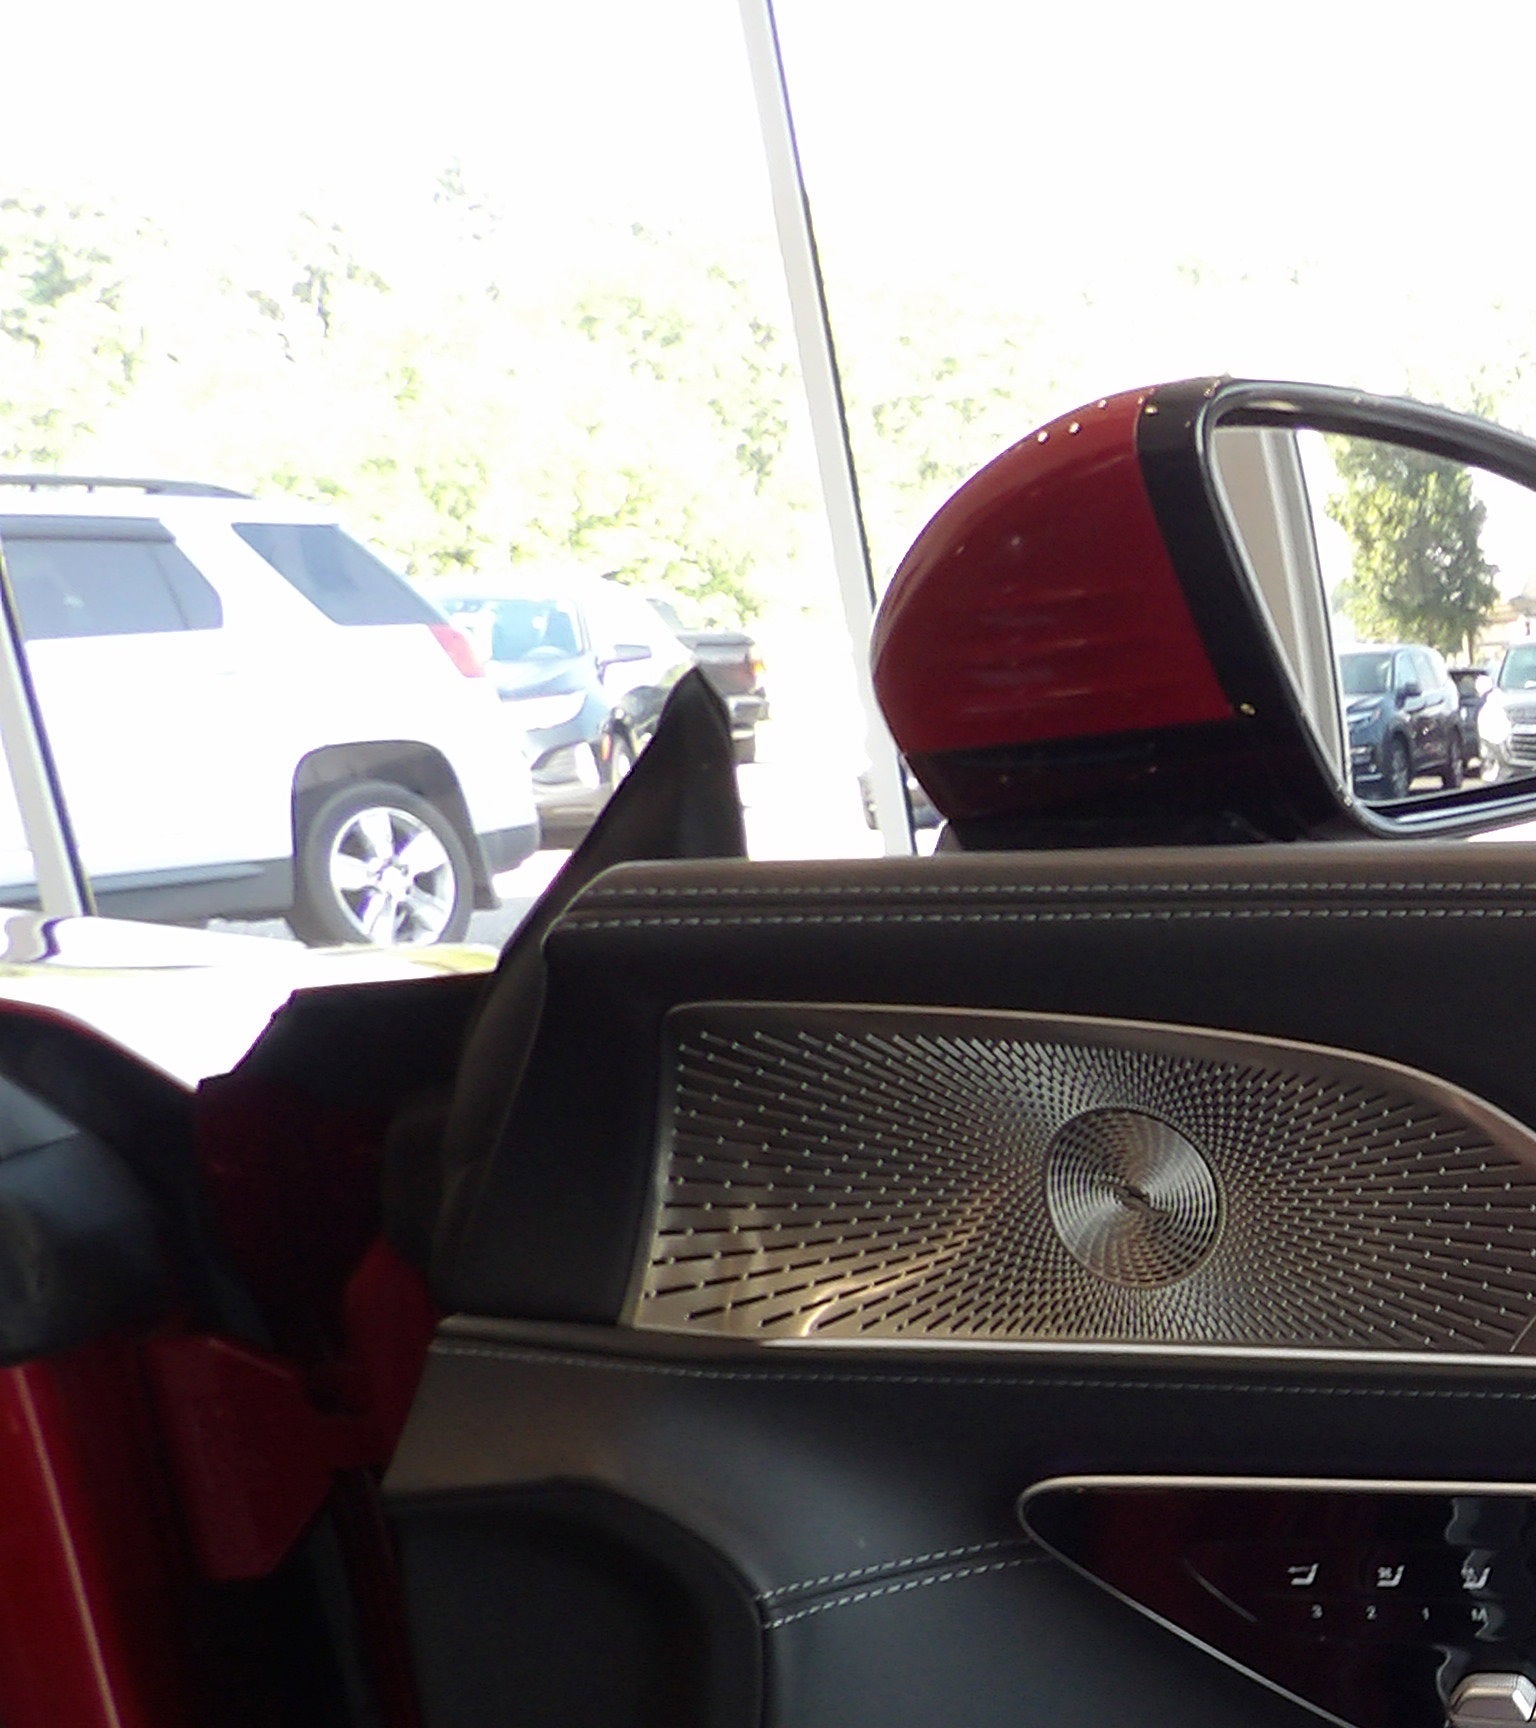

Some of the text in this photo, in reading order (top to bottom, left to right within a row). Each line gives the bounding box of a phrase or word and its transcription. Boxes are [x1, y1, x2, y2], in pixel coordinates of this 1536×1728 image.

[1311, 1604, 1323, 1620] 3
[1366, 1604, 1378, 1621] 2
[1421, 1606, 1430, 1621] 1
